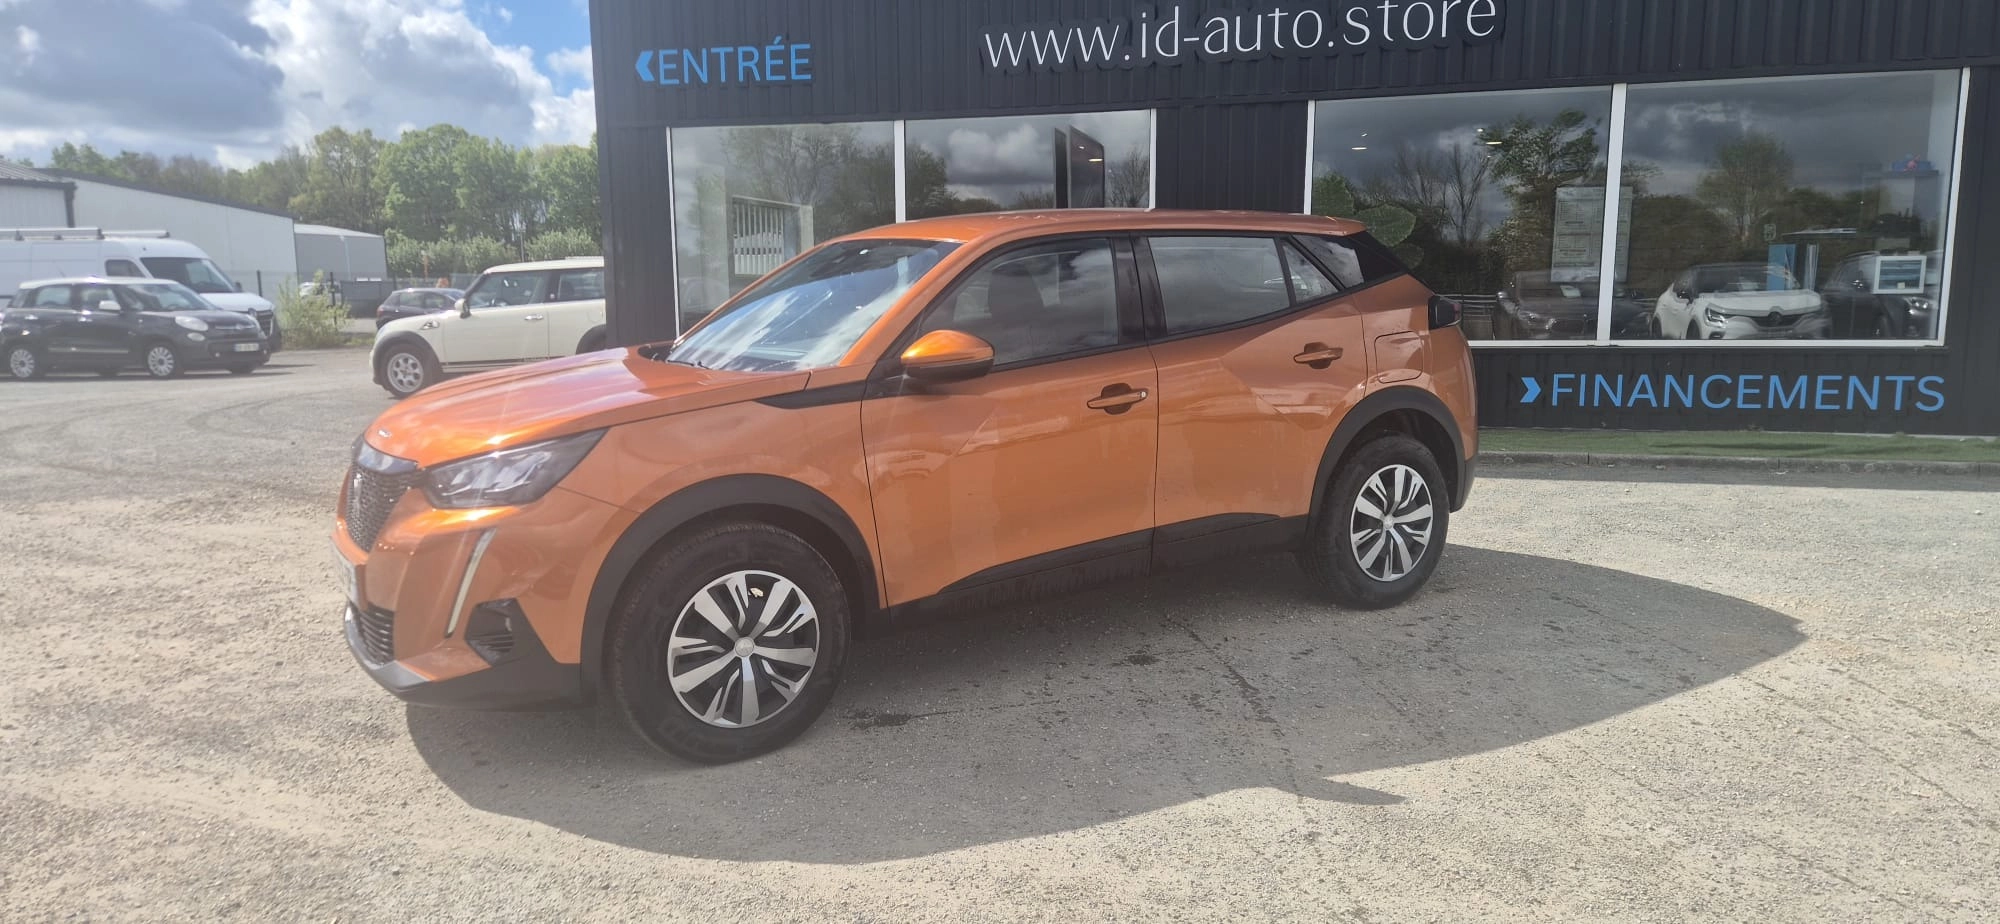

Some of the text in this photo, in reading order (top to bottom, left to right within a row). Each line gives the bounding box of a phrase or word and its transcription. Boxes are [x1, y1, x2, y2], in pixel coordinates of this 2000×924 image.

[984, 0, 1497, 68] www.id-auto.store
[658, 35, 812, 85] ENTRÉE
[1551, 373, 1946, 412] FINANCEMENTS
